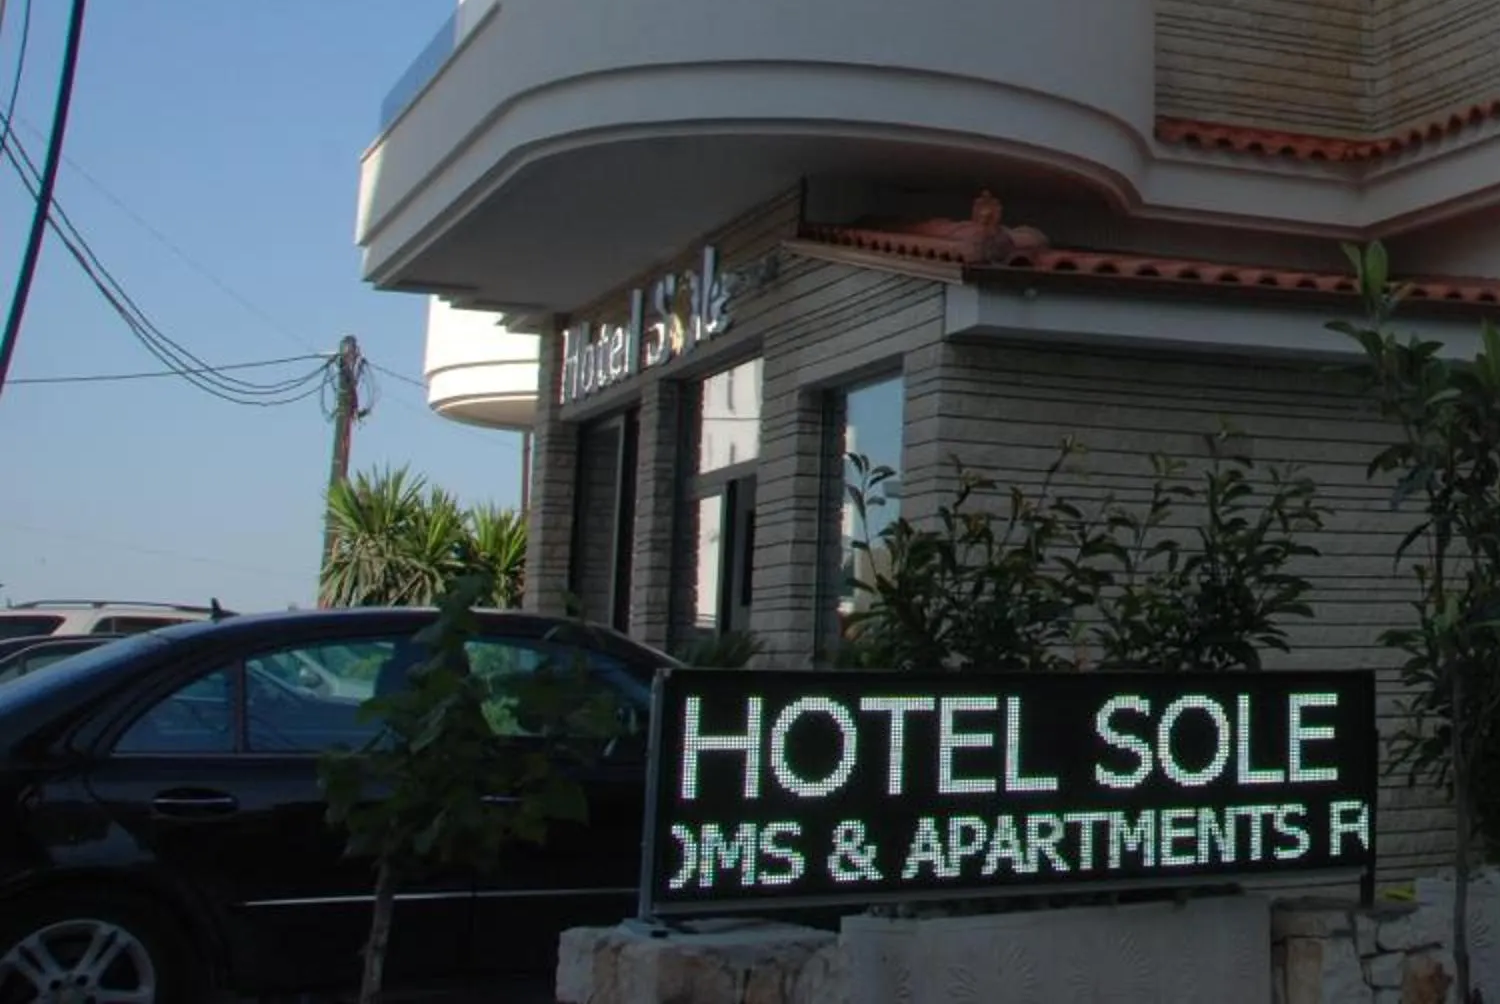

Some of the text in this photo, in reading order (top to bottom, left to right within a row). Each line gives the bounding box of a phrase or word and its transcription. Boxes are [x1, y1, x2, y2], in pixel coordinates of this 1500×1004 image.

[559, 288, 642, 405] Hotel
[680, 692, 1339, 799] HOTEL SOLE
[827, 819, 884, 882] &
[901, 803, 1310, 879] APARTMENTS
